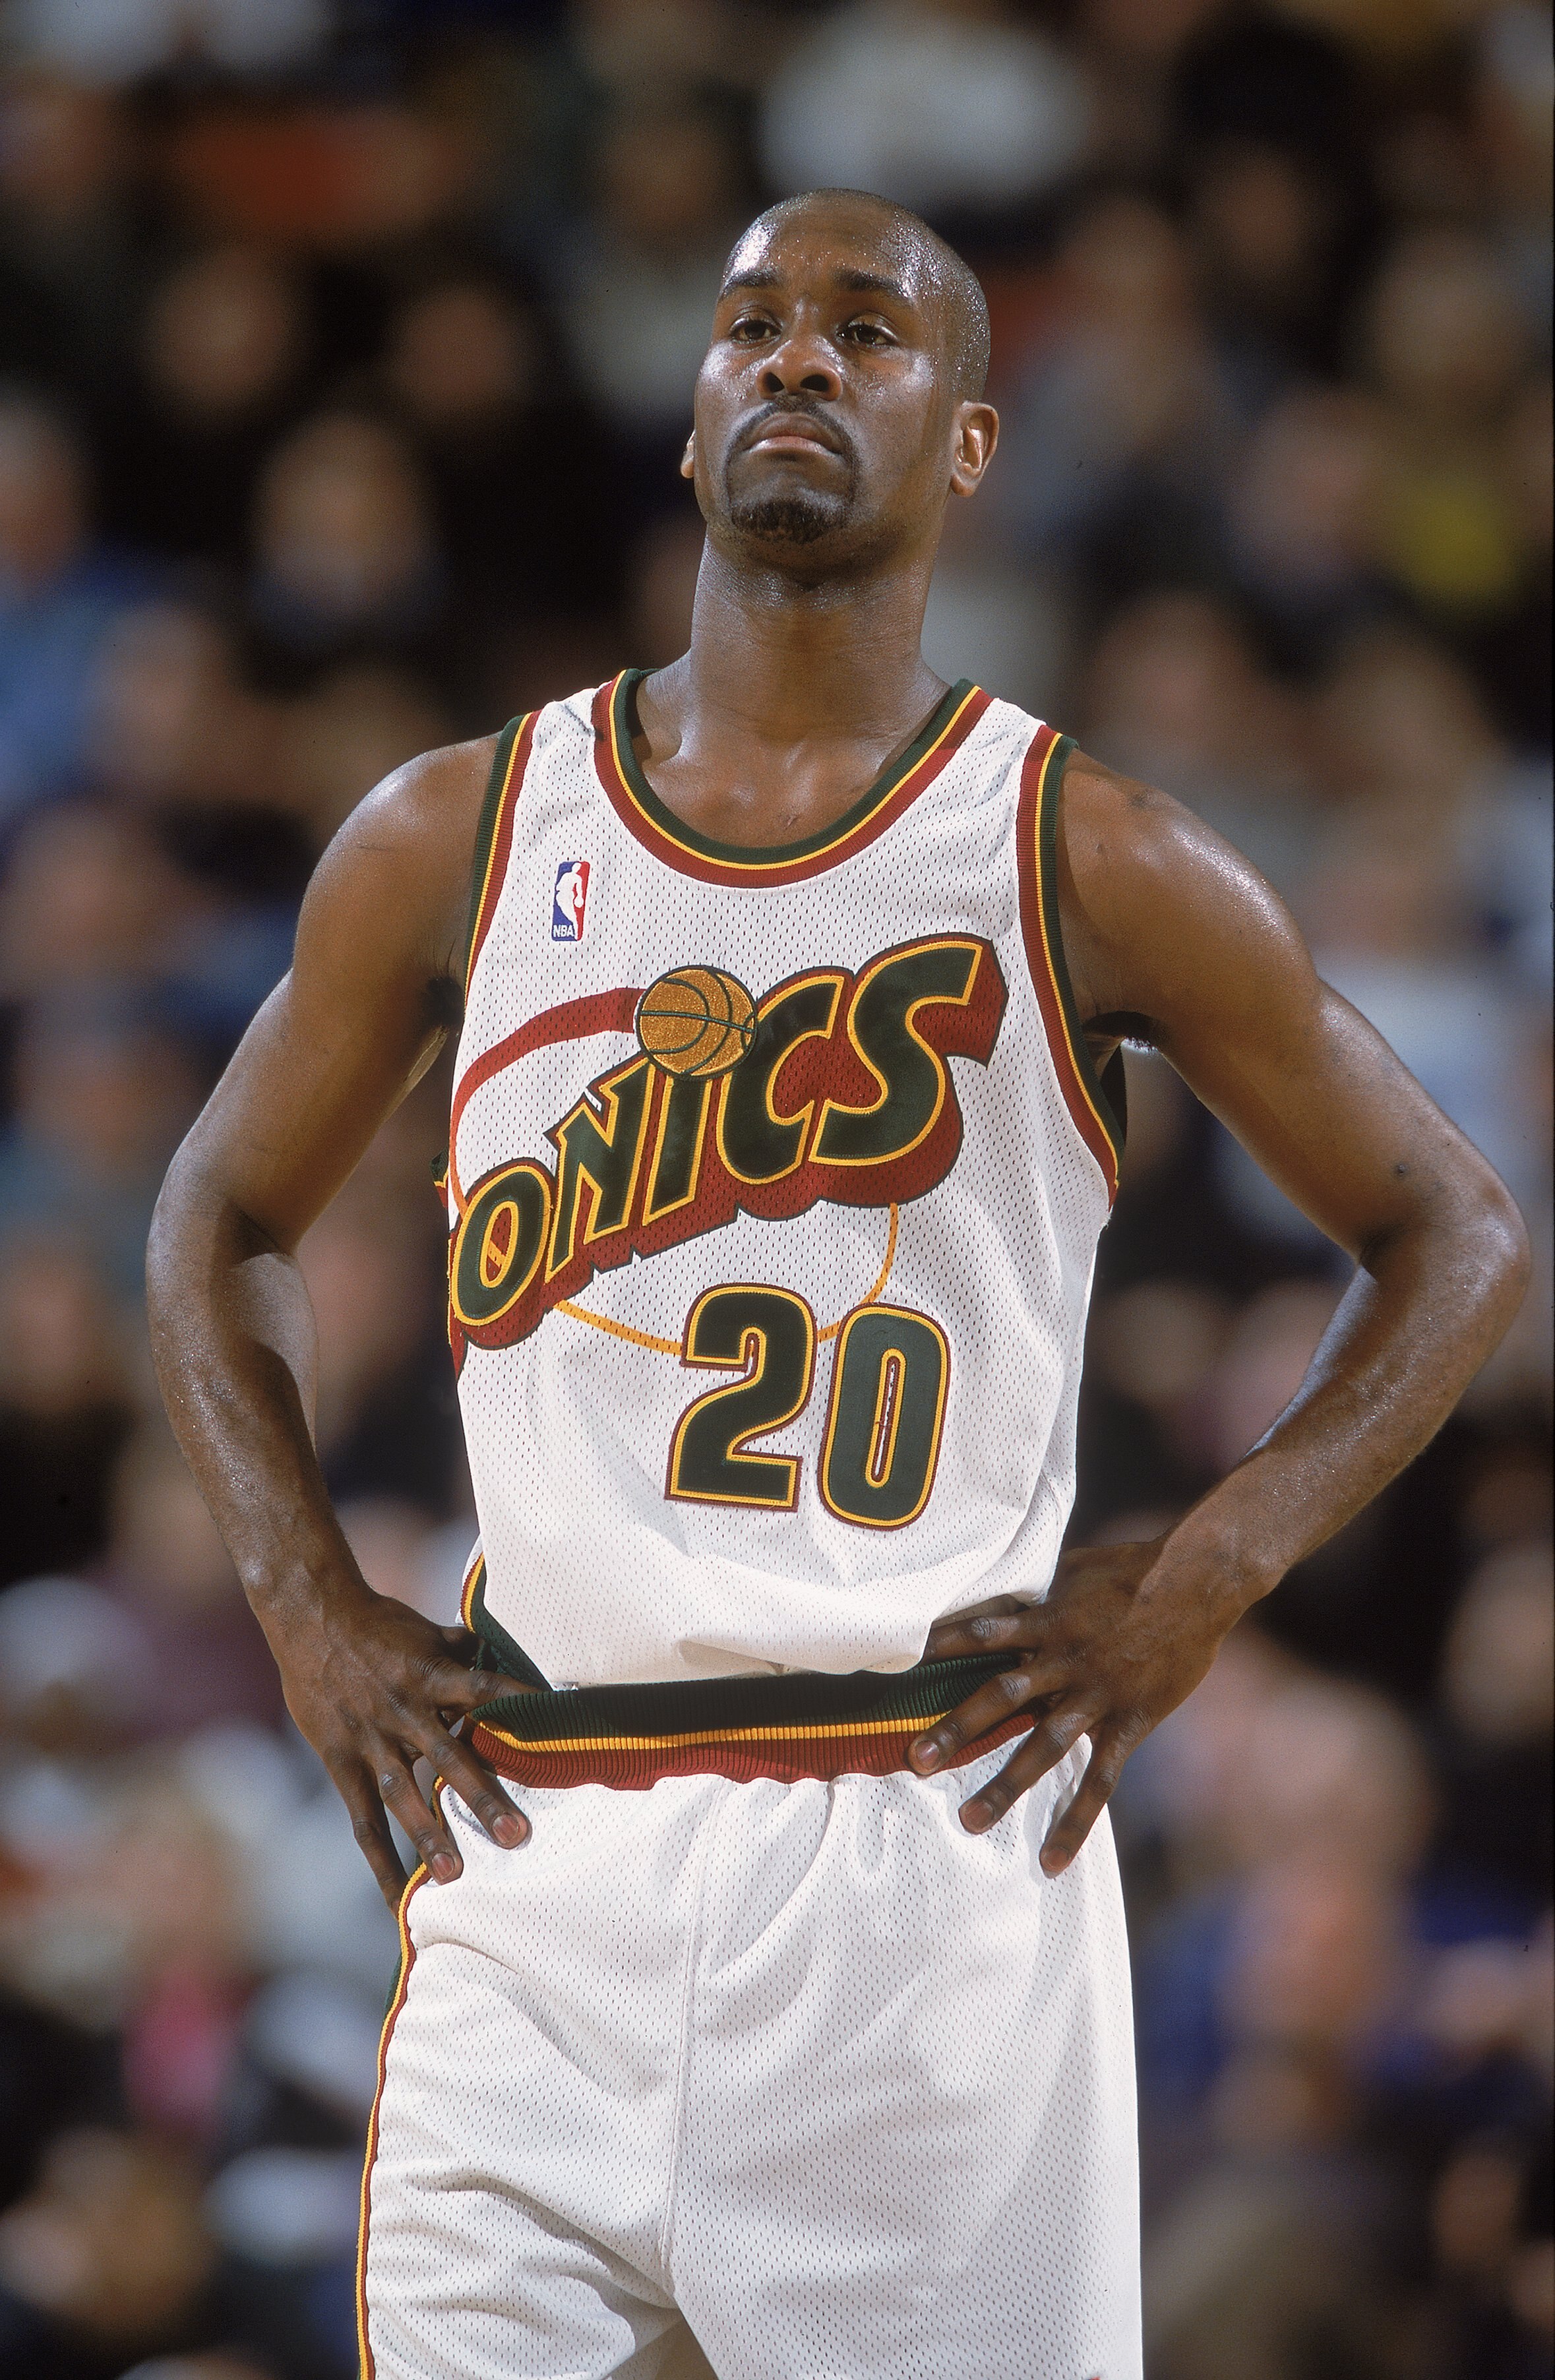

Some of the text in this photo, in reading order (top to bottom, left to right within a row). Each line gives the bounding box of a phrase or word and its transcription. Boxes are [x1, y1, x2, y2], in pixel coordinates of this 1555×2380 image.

[553, 924, 575, 938] NBA
[447, 932, 1008, 1349] ONICS
[664, 1282, 950, 1531] 20
